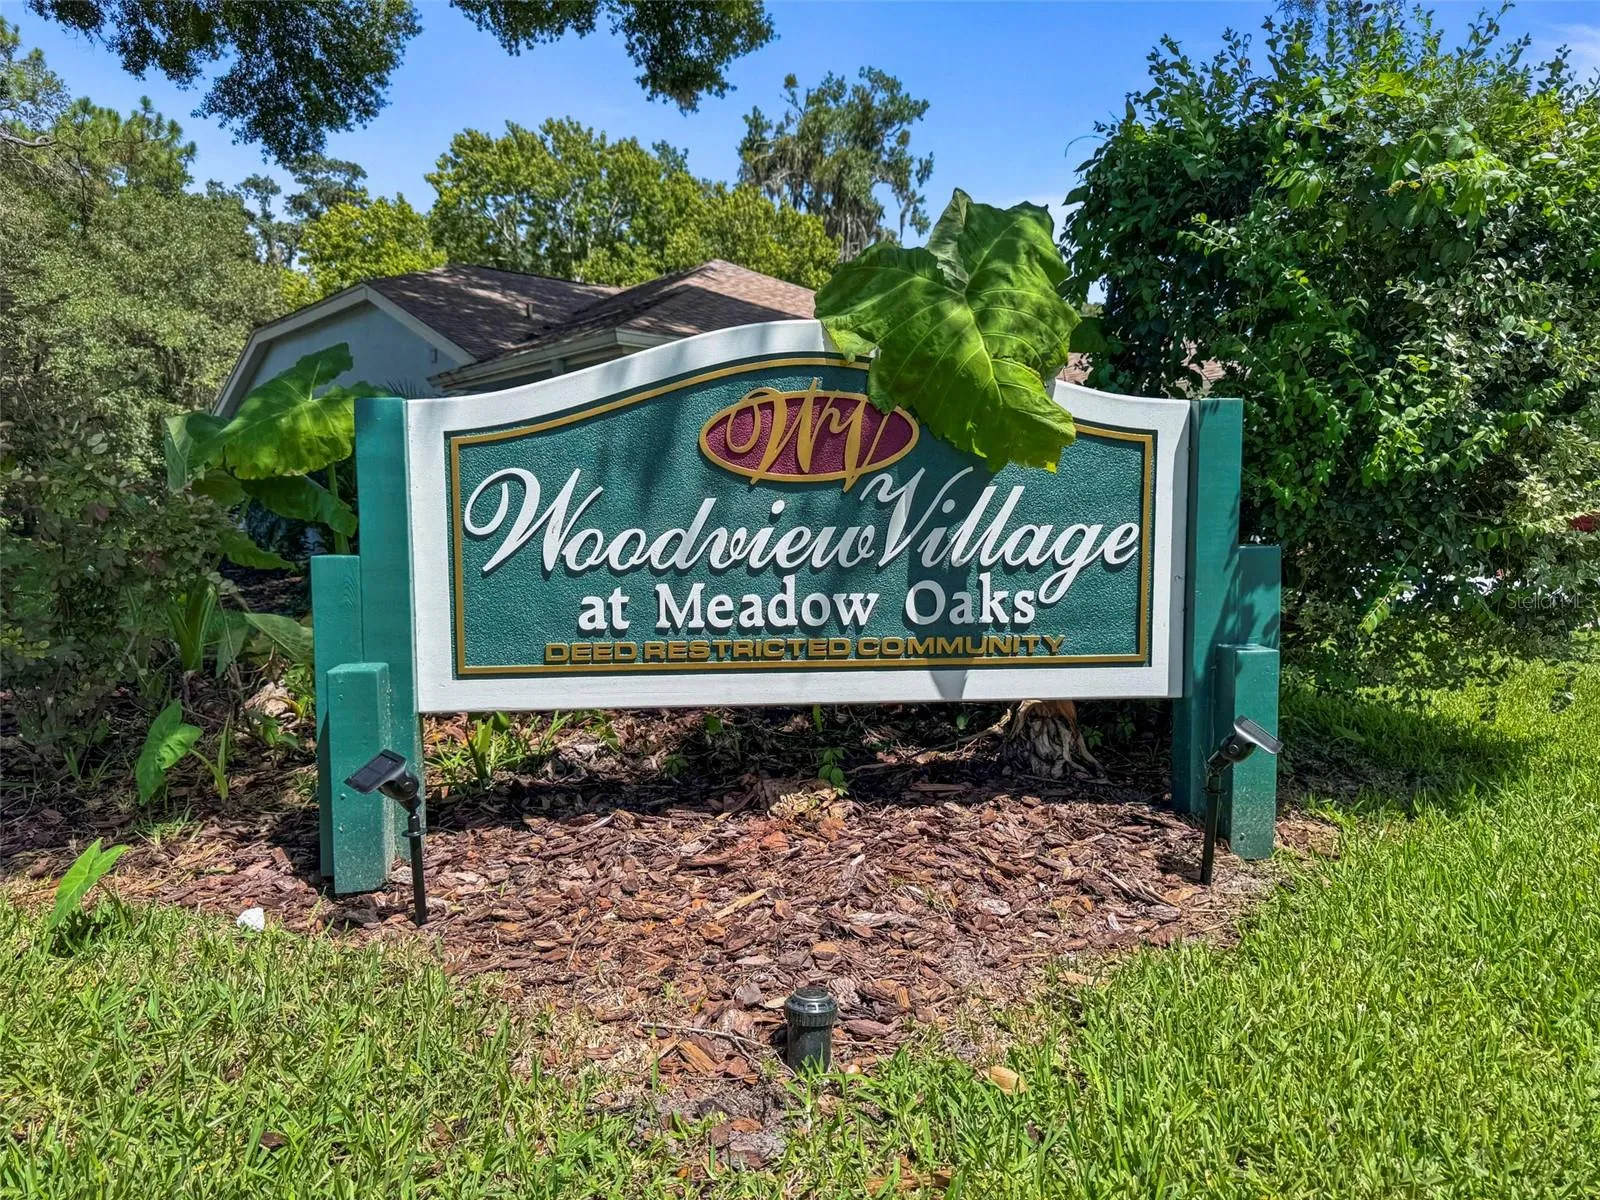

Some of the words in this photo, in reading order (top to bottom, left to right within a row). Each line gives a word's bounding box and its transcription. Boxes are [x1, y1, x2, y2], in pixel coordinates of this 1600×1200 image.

[463, 467, 875, 572] Woodview
[859, 466, 1140, 604] Village
[577, 587, 630, 630] at
[655, 574, 879, 629] Meadow
[905, 572, 1036, 625] Oaks
[544, 642, 637, 663] DEED
[644, 637, 850, 660] RESTRICTED
[857, 635, 1066, 657] COMMUNITY
